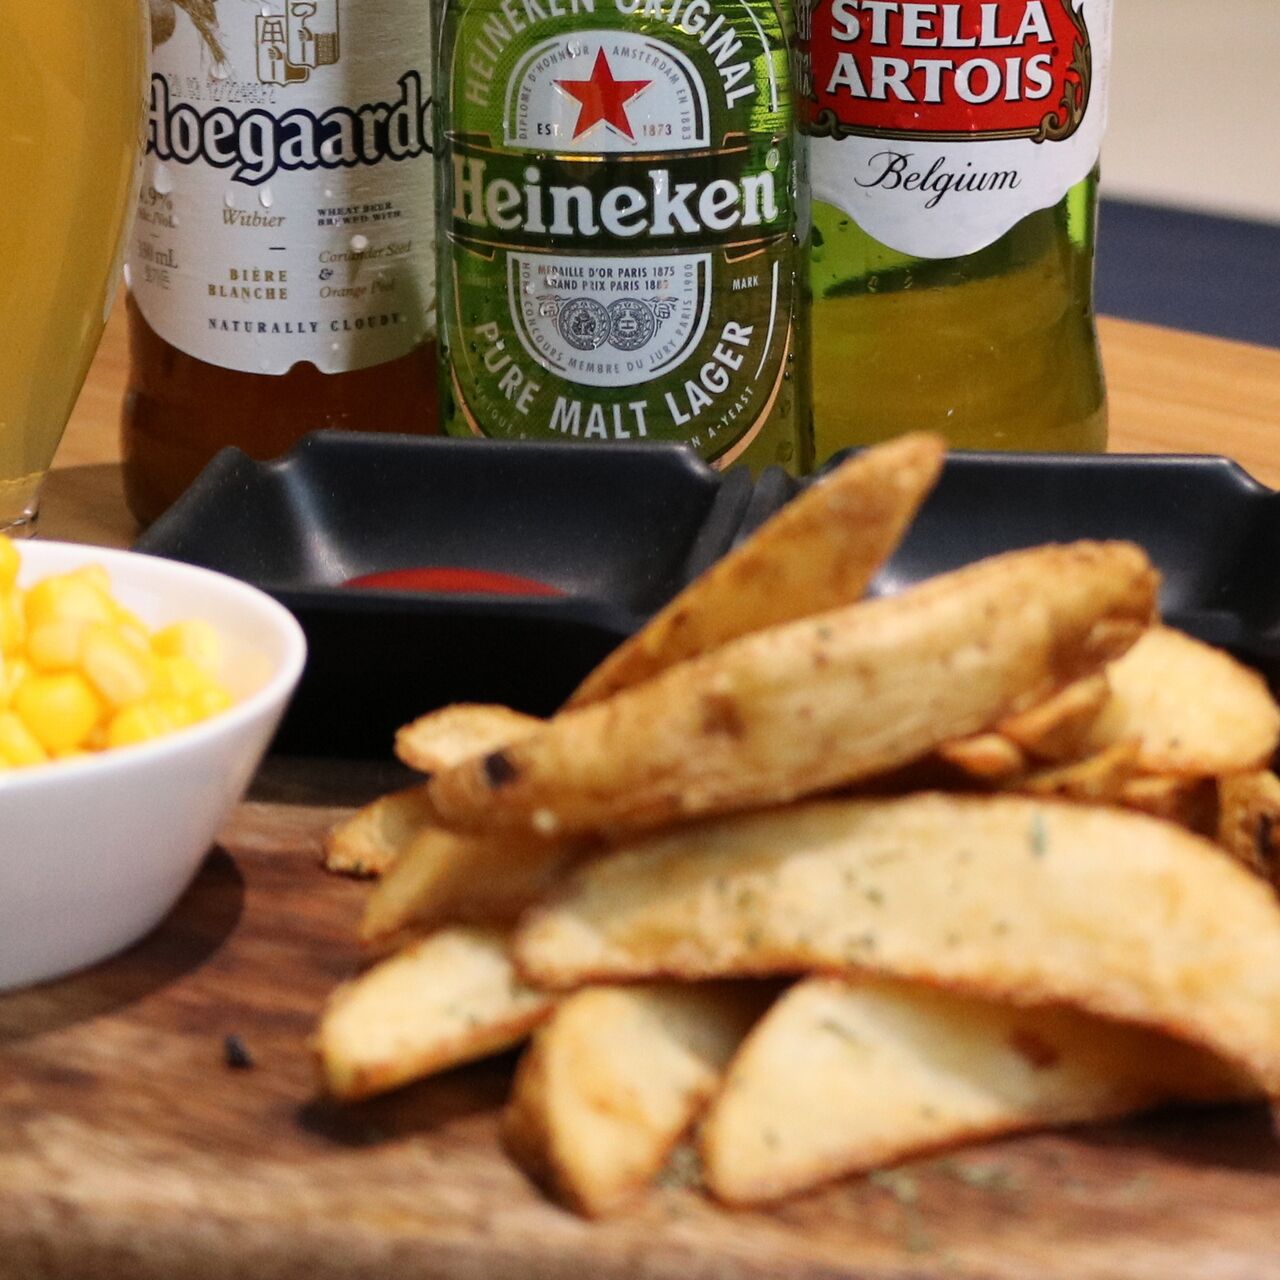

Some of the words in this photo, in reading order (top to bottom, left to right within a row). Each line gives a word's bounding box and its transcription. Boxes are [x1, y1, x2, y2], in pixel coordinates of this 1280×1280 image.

[527, 45, 590, 83] D'HONNUR
[612, 45, 681, 86] AMSTERDAM
[826, 53, 1055, 105] ARTOIS
[676, 88, 689, 106] EN
[519, 85, 532, 140] DIPLOME
[146, 70, 434, 186] Hoegaard
[642, 124, 672, 137] 1873
[681, 110, 692, 142] 1883
[854, 151, 1022, 210] Belgium
[452, 155, 778, 238] Heineken
[222, 207, 286, 228] Witbier
[317, 205, 360, 217] WHEAT
[362, 201, 393, 214] BEER
[372, 210, 401, 222] WITH
[229, 266, 288, 282] BIÈRE
[318, 267, 335, 281] &
[538, 264, 584, 278] MEDAILLE
[589, 266, 613, 278] D'OR
[618, 267, 647, 278] PARIS
[653, 266, 675, 277] 1875
[683, 263, 694, 292] 1900
[208, 283, 288, 300] BLANCHE
[610, 280, 639, 291] PARIS
[732, 275, 759, 291] MARK
[208, 317, 317, 333] NATURALLY
[330, 312, 400, 333] CLOUDY
[676, 299, 692, 336] PARIS
[524, 301, 563, 362] CONCOURS
[650, 340, 677, 364] JURY
[568, 357, 620, 374] MEMBRE
[627, 360, 643, 371] DU
[474, 321, 540, 415] PURE
[548, 396, 648, 440] MALT
[664, 321, 754, 426] LAGER
[707, 385, 754, 439] A-YEAST
